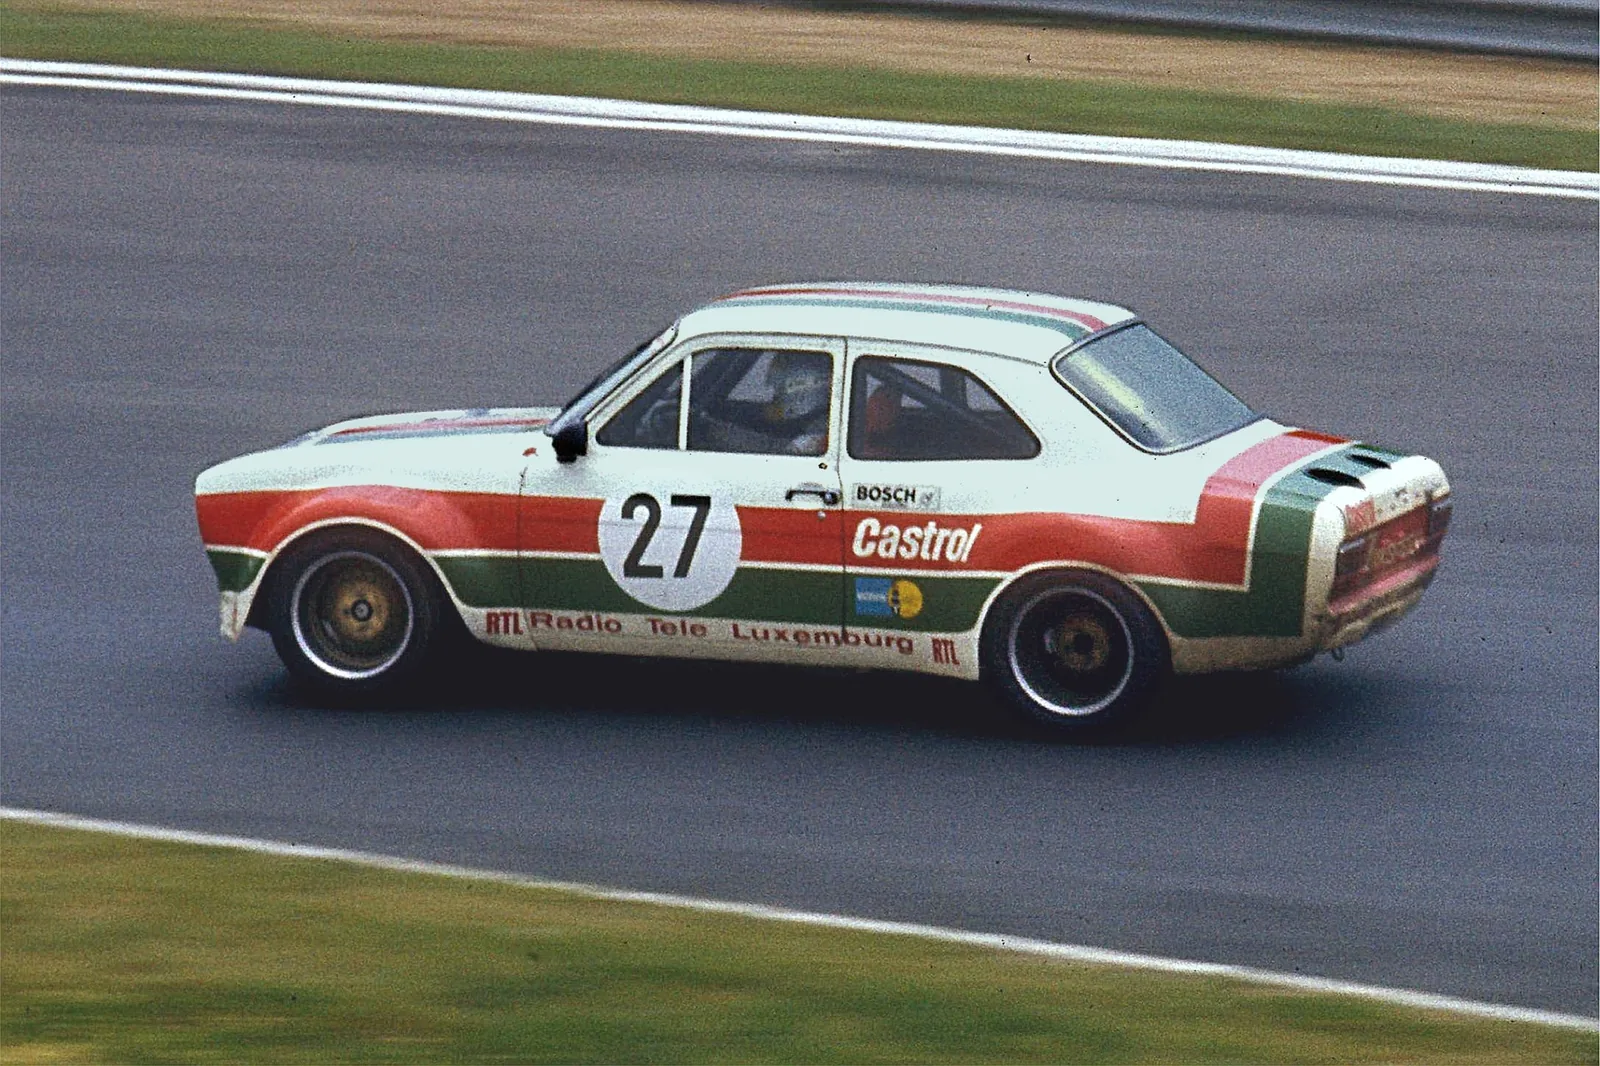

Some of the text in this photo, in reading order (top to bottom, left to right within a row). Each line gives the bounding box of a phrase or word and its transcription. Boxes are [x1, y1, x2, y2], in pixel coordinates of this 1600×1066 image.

[857, 485, 916, 503] BOSCH
[621, 492, 711, 578] 27
[852, 517, 983, 563] Castrol
[486, 611, 523, 635] RTL
[530, 611, 914, 655] Radio Tele Luxemburg
[931, 637, 961, 666] RTL
